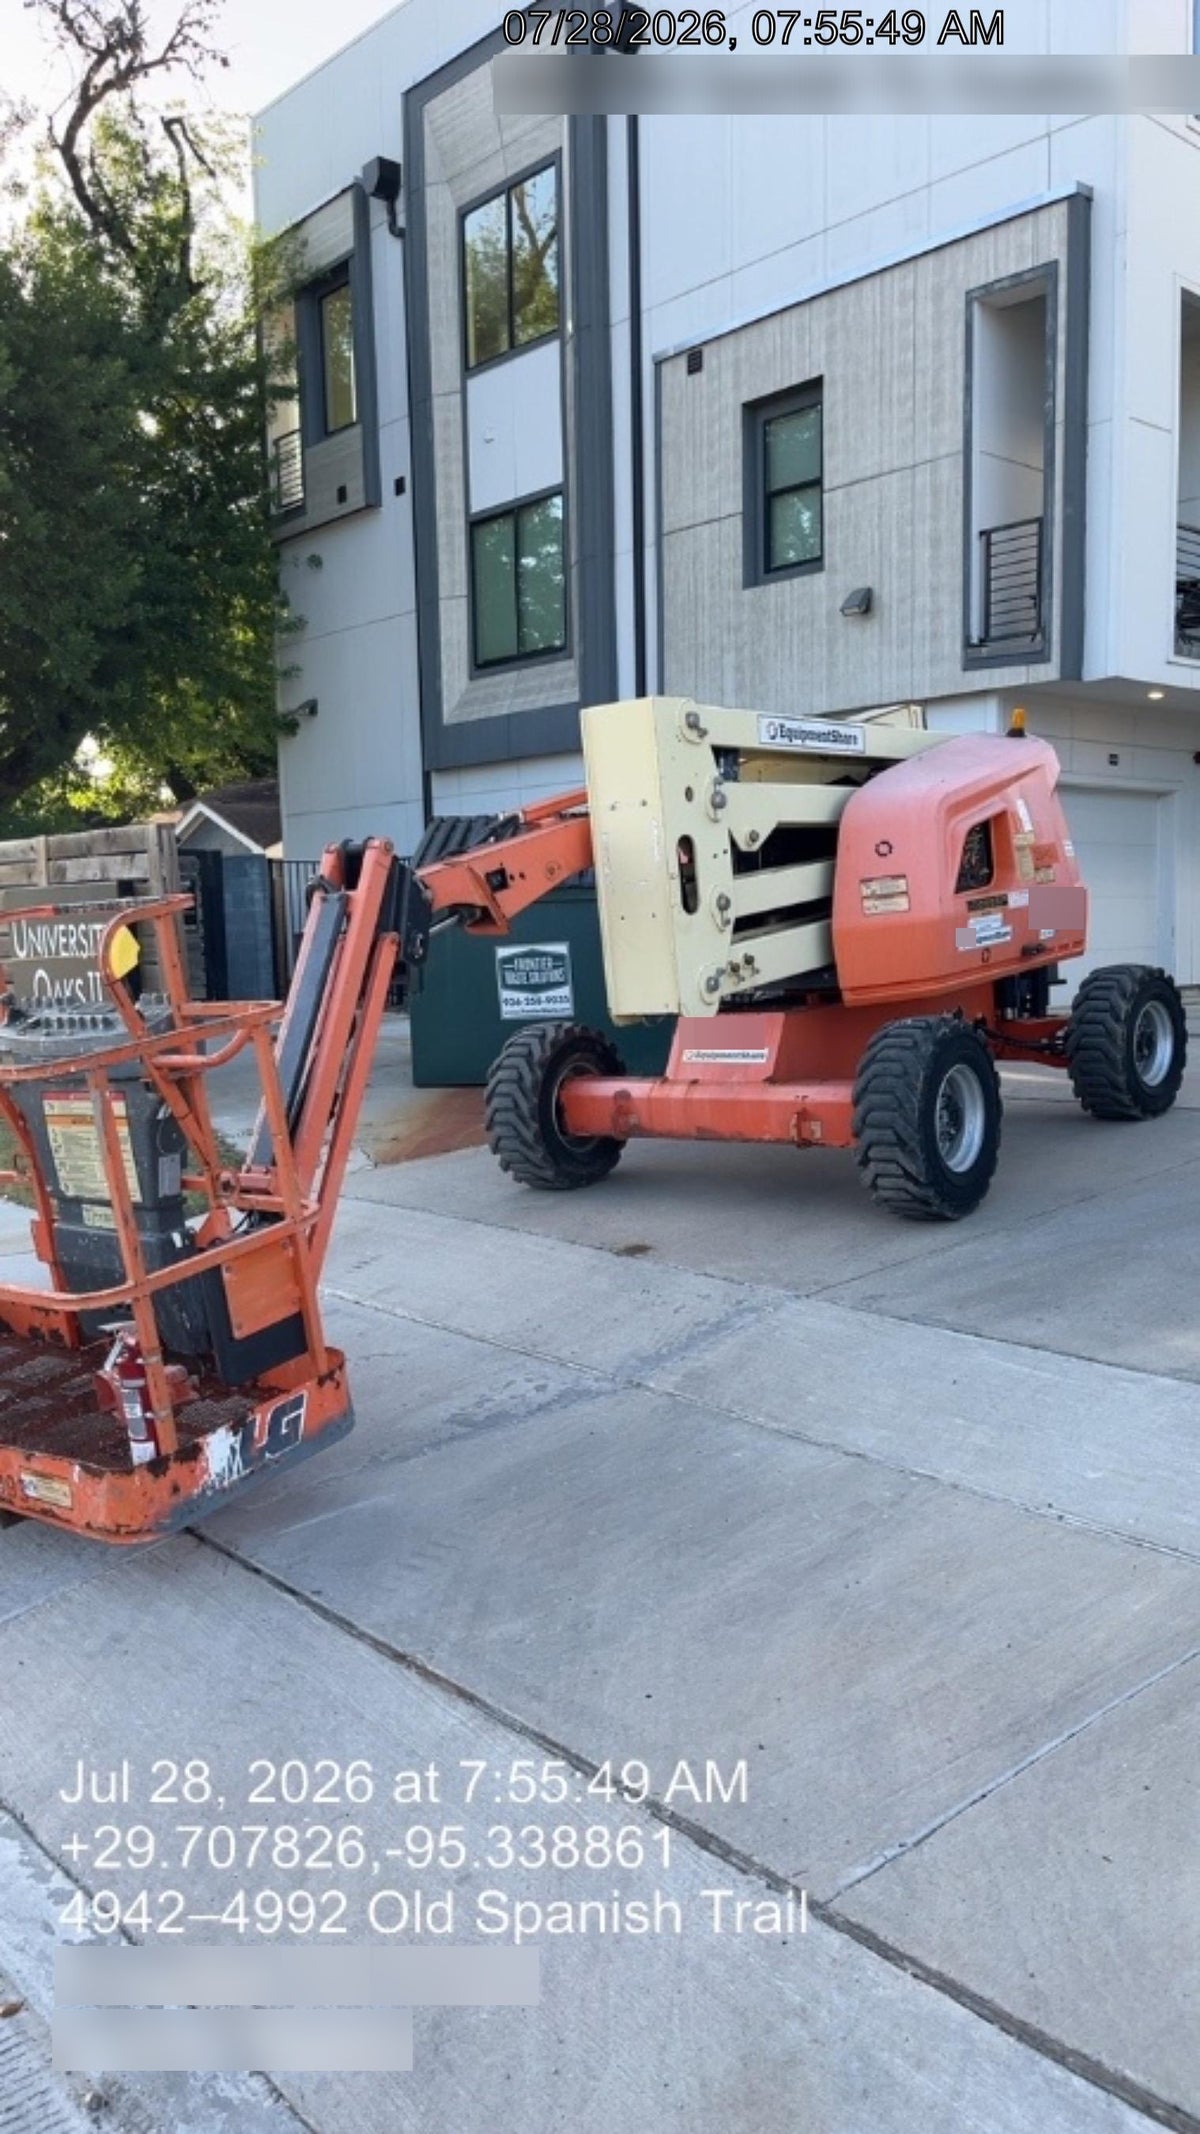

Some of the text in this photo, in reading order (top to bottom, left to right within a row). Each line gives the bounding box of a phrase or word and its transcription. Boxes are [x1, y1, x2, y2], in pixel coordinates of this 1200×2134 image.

[779, 722, 859, 747] EquipmentShare
[11, 919, 106, 960] UNIVERSIT
[514, 956, 553, 971] FRONTIER
